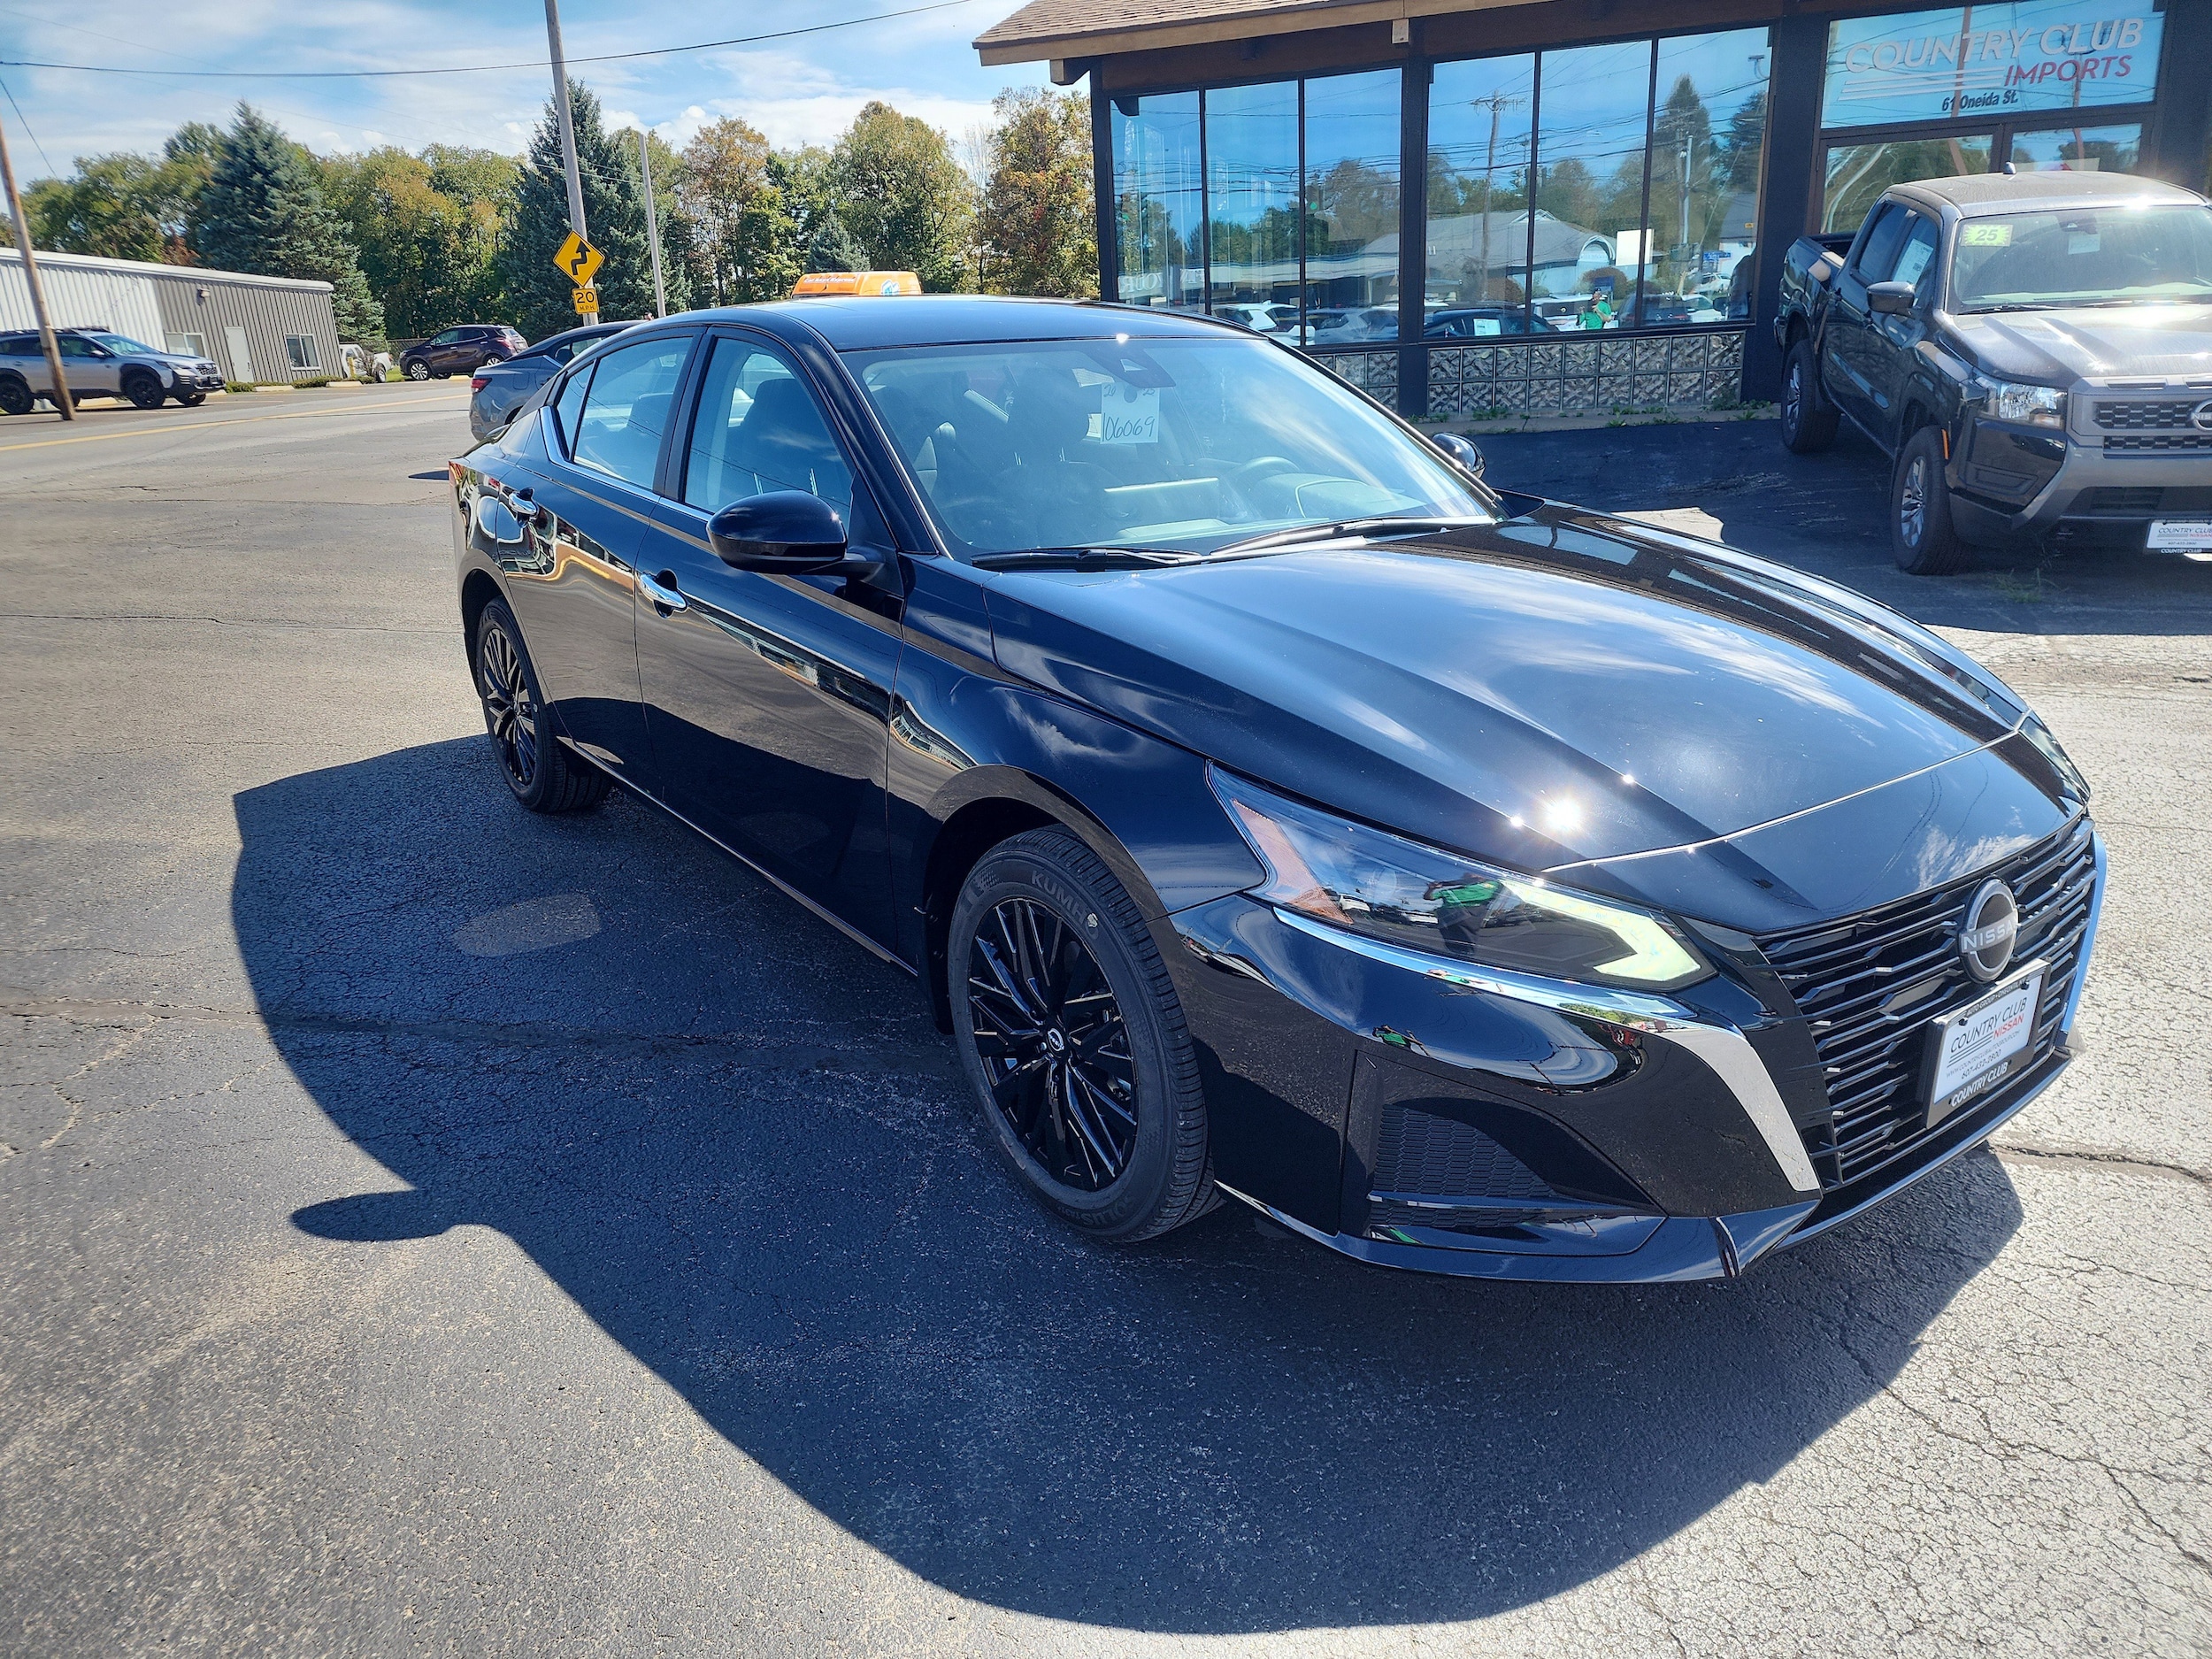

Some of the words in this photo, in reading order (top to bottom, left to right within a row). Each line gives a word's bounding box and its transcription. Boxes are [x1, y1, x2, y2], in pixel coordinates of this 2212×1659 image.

[1845, 28, 2032, 73] COUNTRY
[2039, 18, 2145, 56] CLUB
[2003, 55, 2133, 88] IMPORTS
[1940, 96, 1959, 111] 61
[1959, 90, 2000, 110] Oneida
[1974, 228, 1999, 242] 25
[576, 292, 594, 303] 20
[1102, 412, 1156, 442] 106069
[1964, 919, 2016, 949] NISSA
[1950, 1011, 2001, 1053] COUNTRY
[2002, 996, 2028, 1022] CLUB
[1993, 1013, 2024, 1040] NISSAN
[1951, 1072, 1990, 1108] COUNTRY
[1986, 1061, 2008, 1085] CLUB
